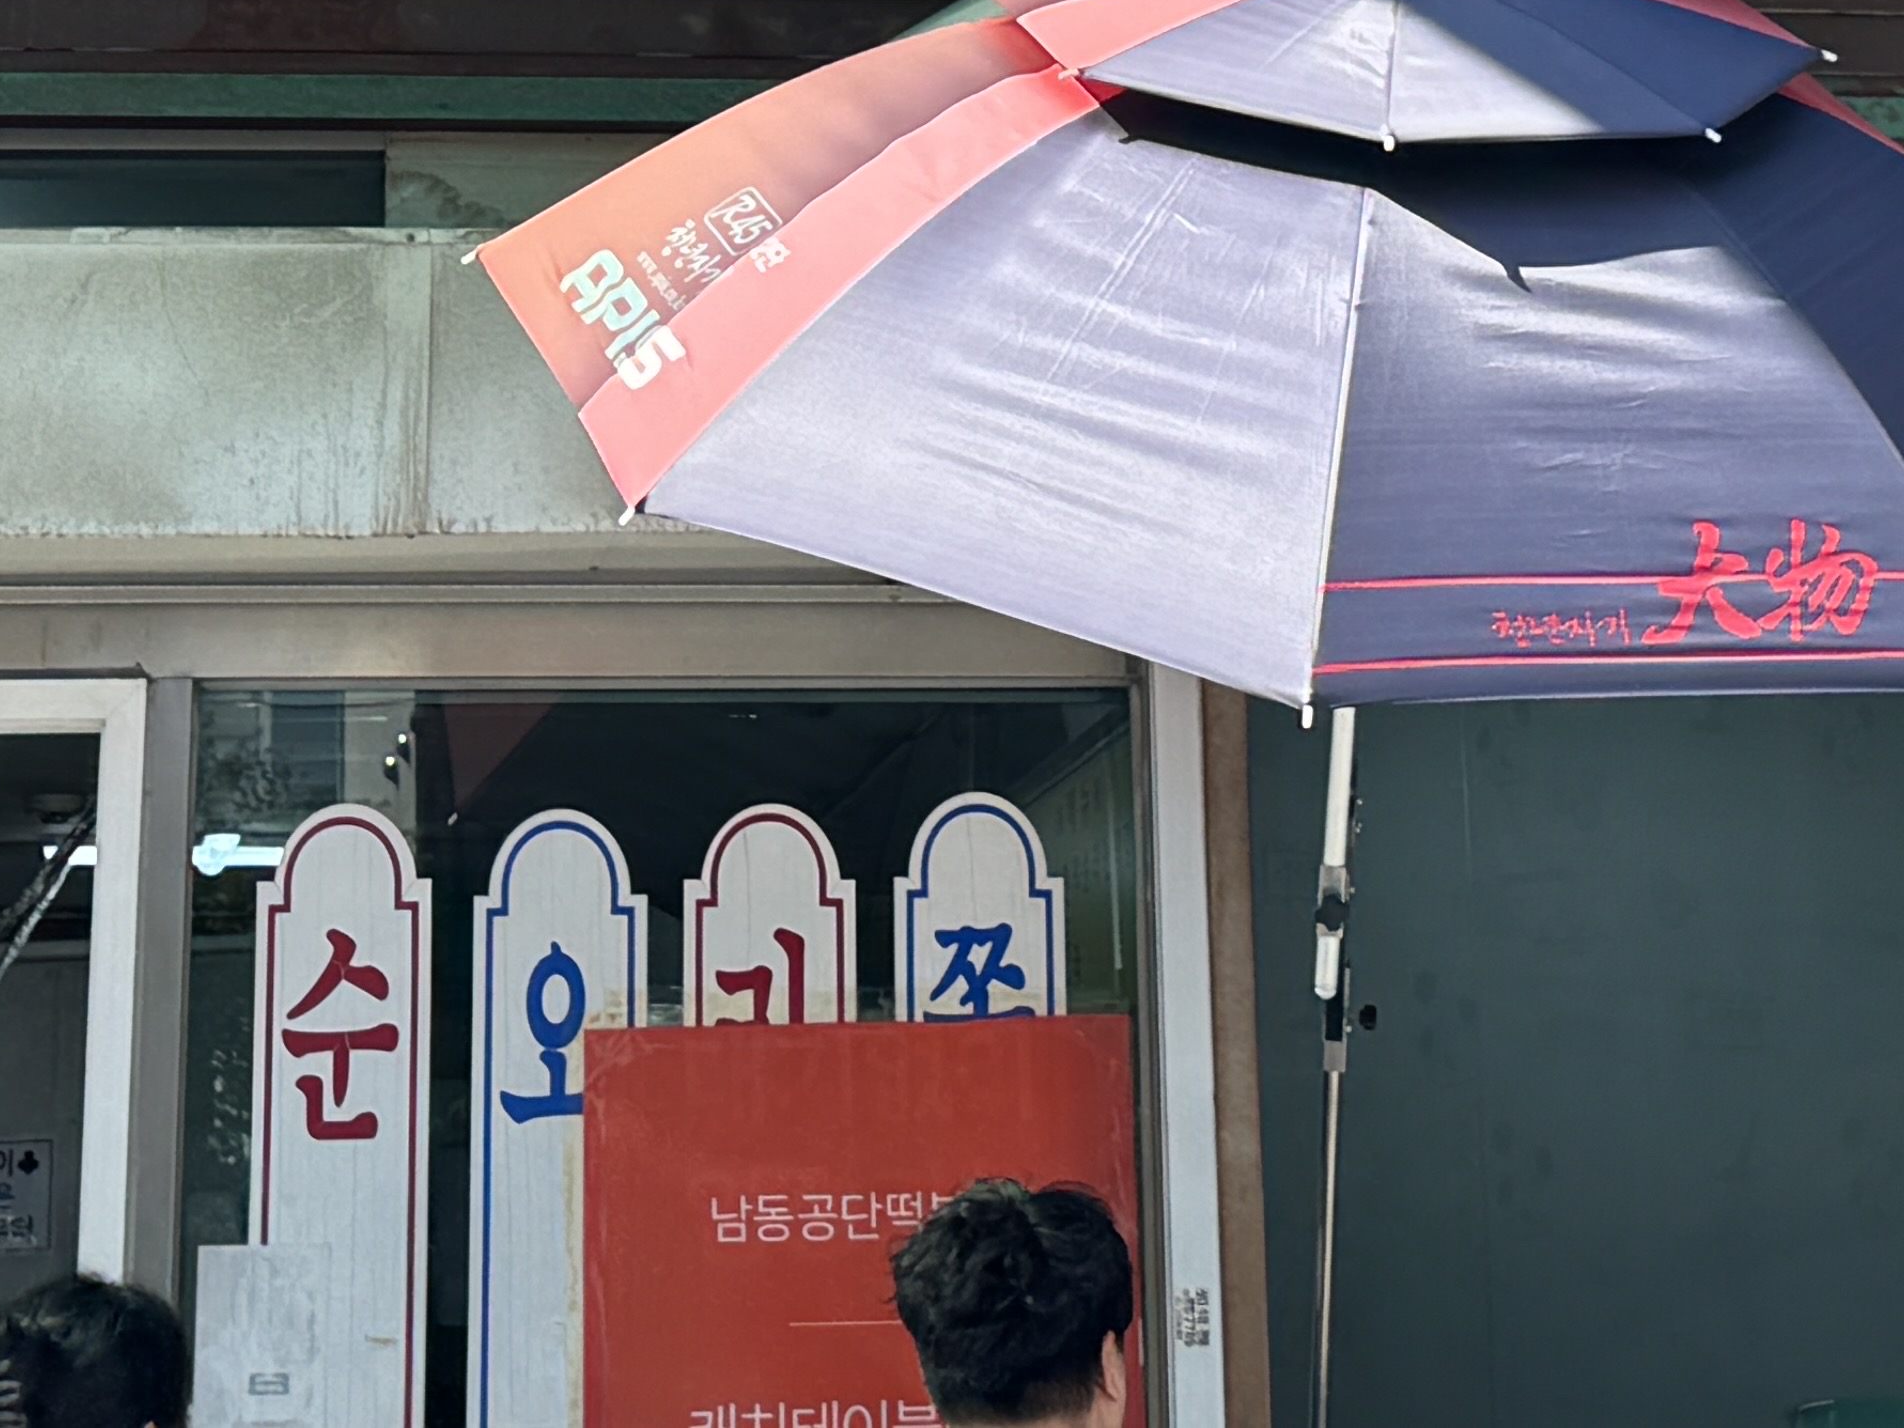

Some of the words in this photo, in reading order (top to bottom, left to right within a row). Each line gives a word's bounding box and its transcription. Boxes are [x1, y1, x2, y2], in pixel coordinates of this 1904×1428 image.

[558, 248, 688, 391] APIS
[1642, 518, 1880, 644] 大物
[281, 927, 400, 1142] 순
[498, 940, 586, 1126] 오
[709, 1190, 956, 1243] 남동공단떡
